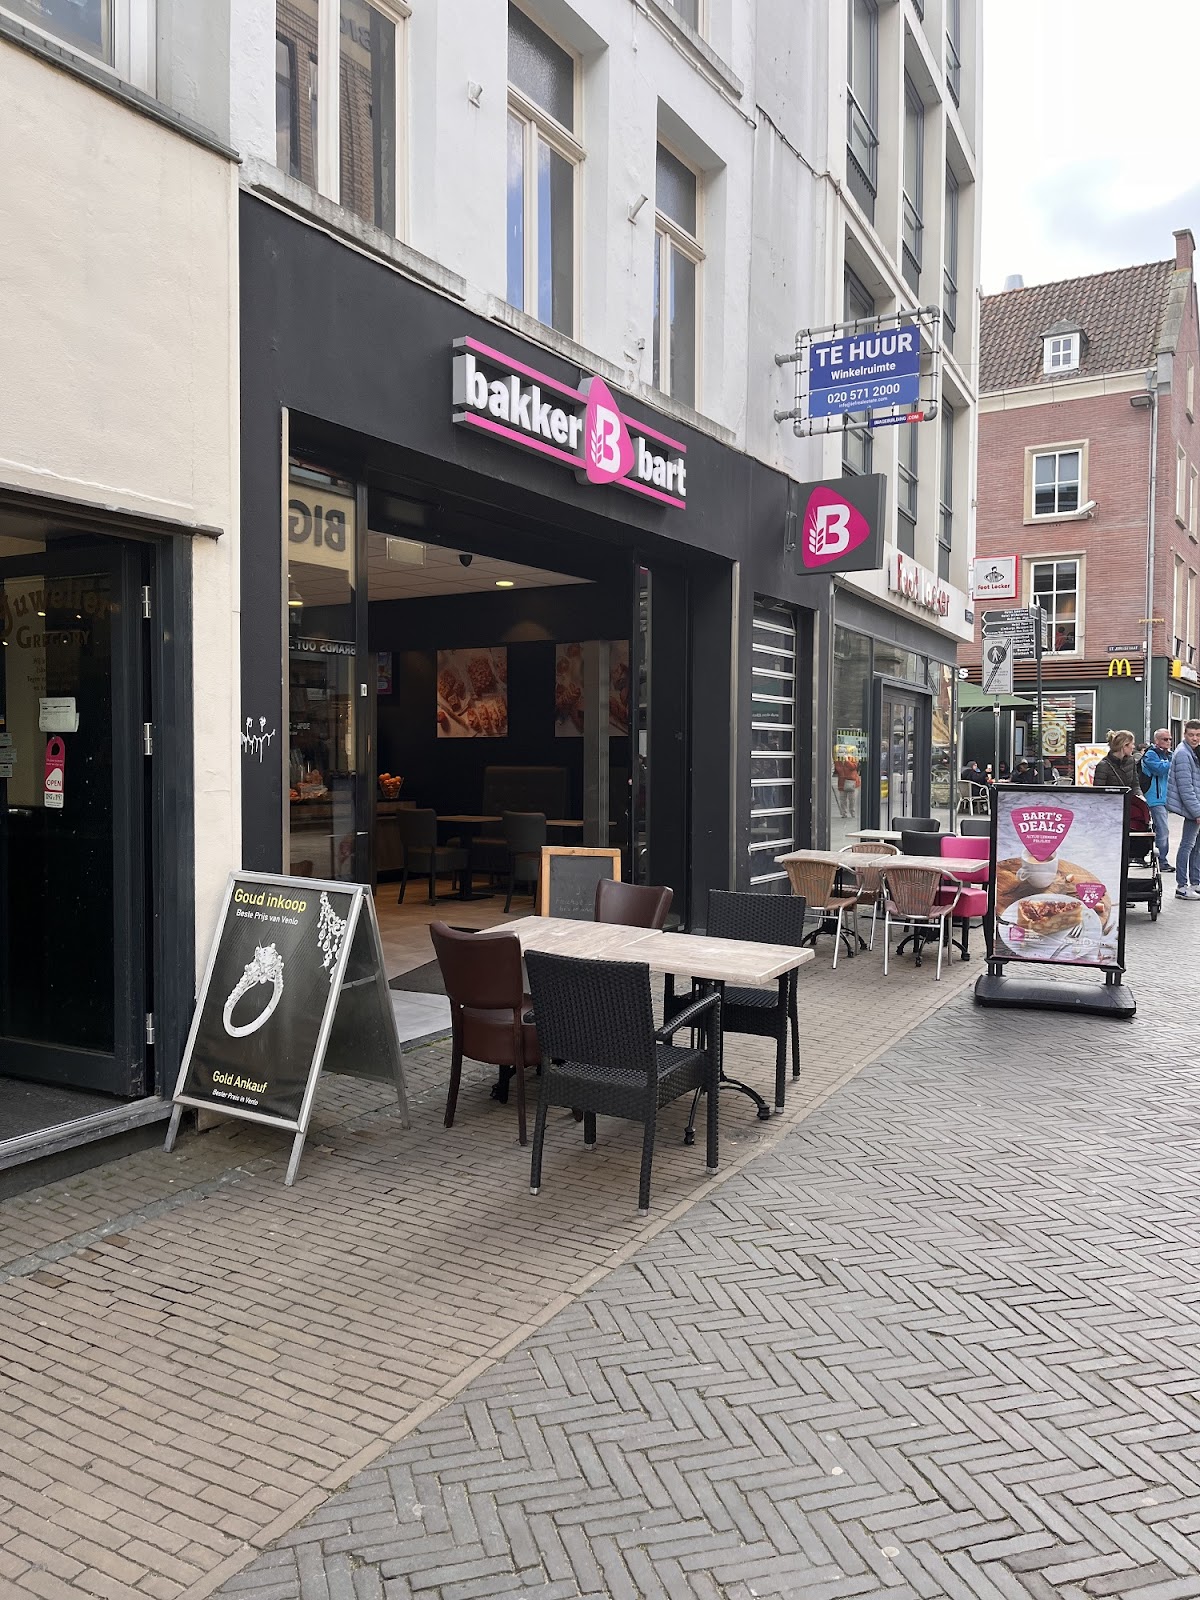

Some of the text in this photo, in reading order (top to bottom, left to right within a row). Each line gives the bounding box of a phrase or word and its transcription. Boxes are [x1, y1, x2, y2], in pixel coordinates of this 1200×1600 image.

[816, 332, 913, 367] TE HUUR
[831, 362, 896, 380] Winkelruimte
[827, 383, 900, 404] 020 571 2000
[465, 353, 582, 449] bakker
[638, 436, 686, 497] bart
[815, 504, 850, 555] B
[47, 779, 62, 787] OPEN
[1022, 811, 1063, 822] BART'S
[1018, 821, 1066, 834] DEALS
[234, 888, 307, 913] Goud inkoop
[236, 908, 299, 925] Beste Prijs van Venlo
[212, 1070, 268, 1094] Gold Ankauf
[212, 1088, 228, 1098] Bester
[240, 1095, 245, 1103] in
[245, 1096, 259, 1106] Venlo
